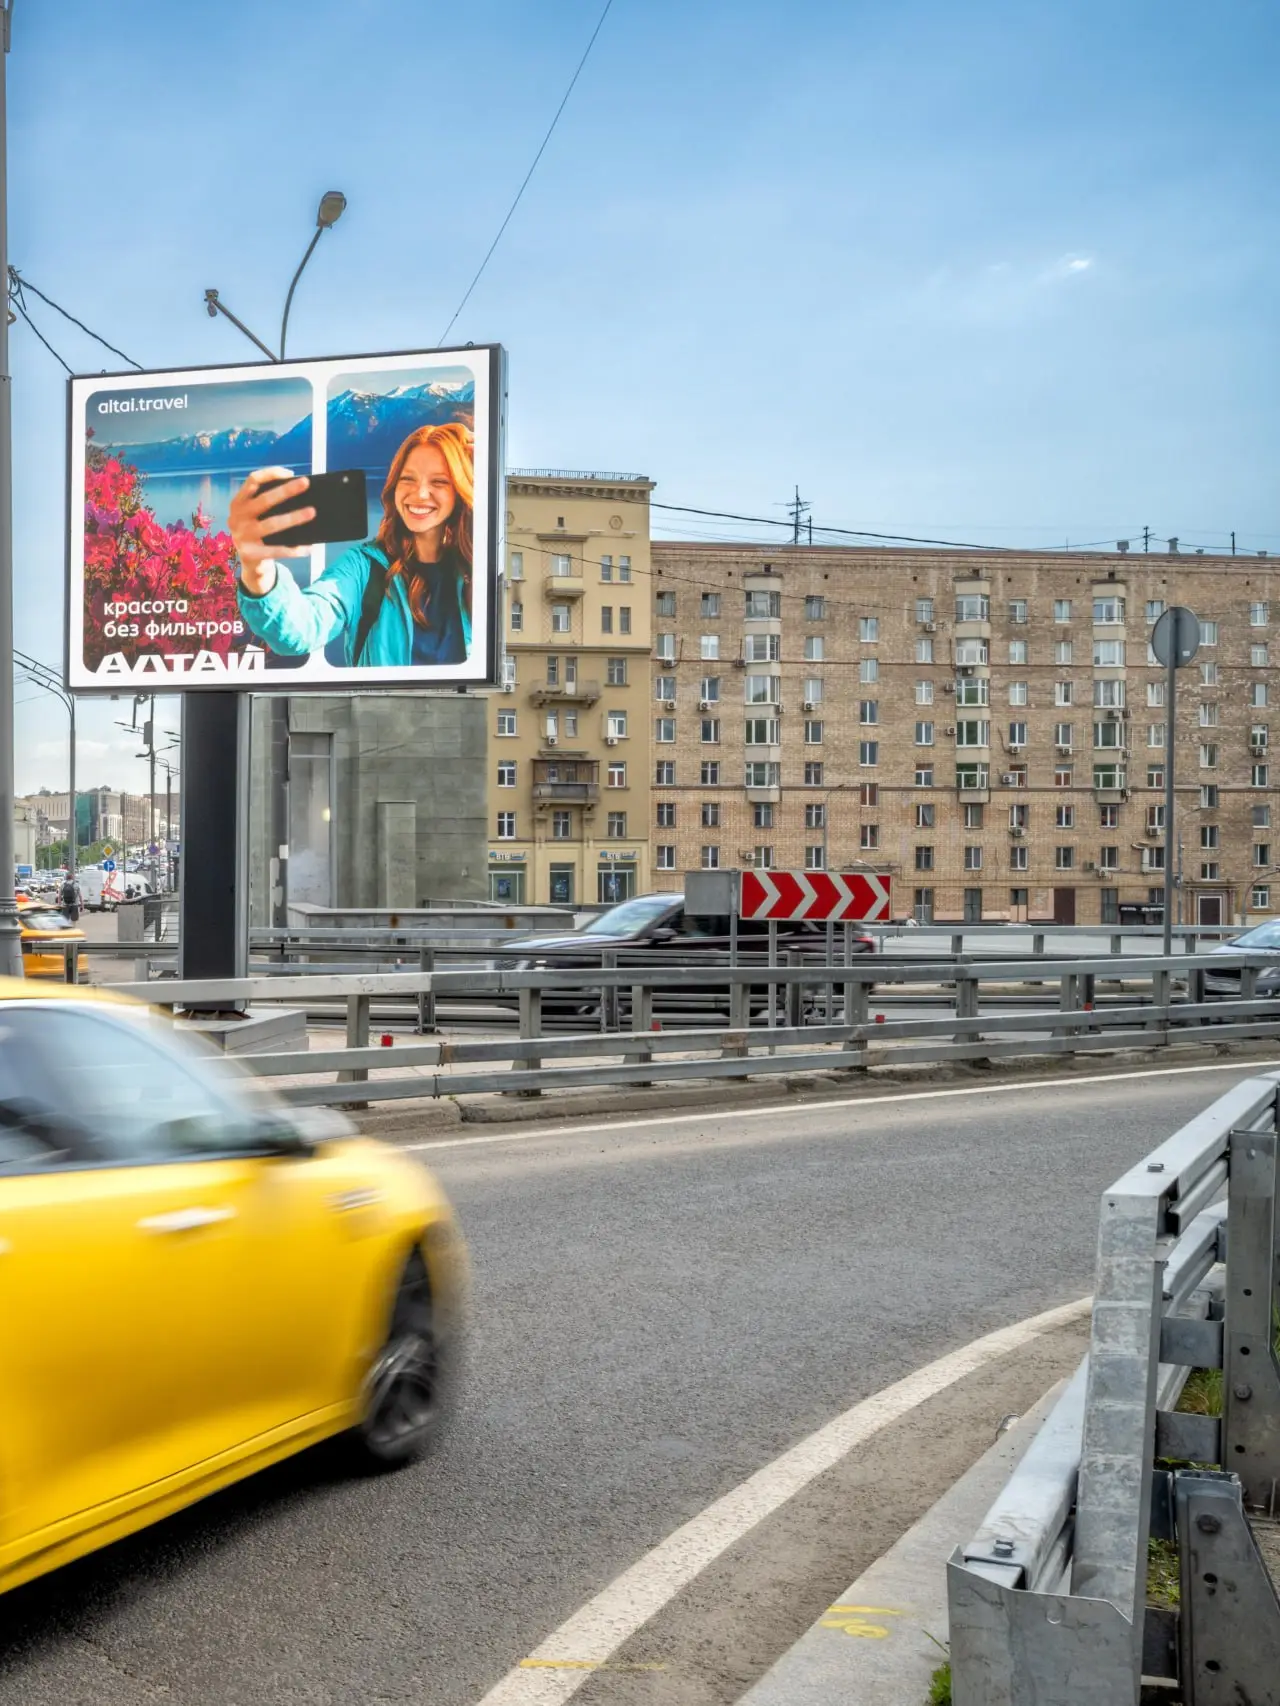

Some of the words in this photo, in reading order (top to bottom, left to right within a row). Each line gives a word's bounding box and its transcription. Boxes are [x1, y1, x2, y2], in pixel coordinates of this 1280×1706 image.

[97, 393, 188, 414] altai.travel
[103, 599, 188, 619] красота
[103, 620, 140, 638] без
[145, 619, 244, 640] фильтров
[95, 643, 265, 673] АЛТАЙ
